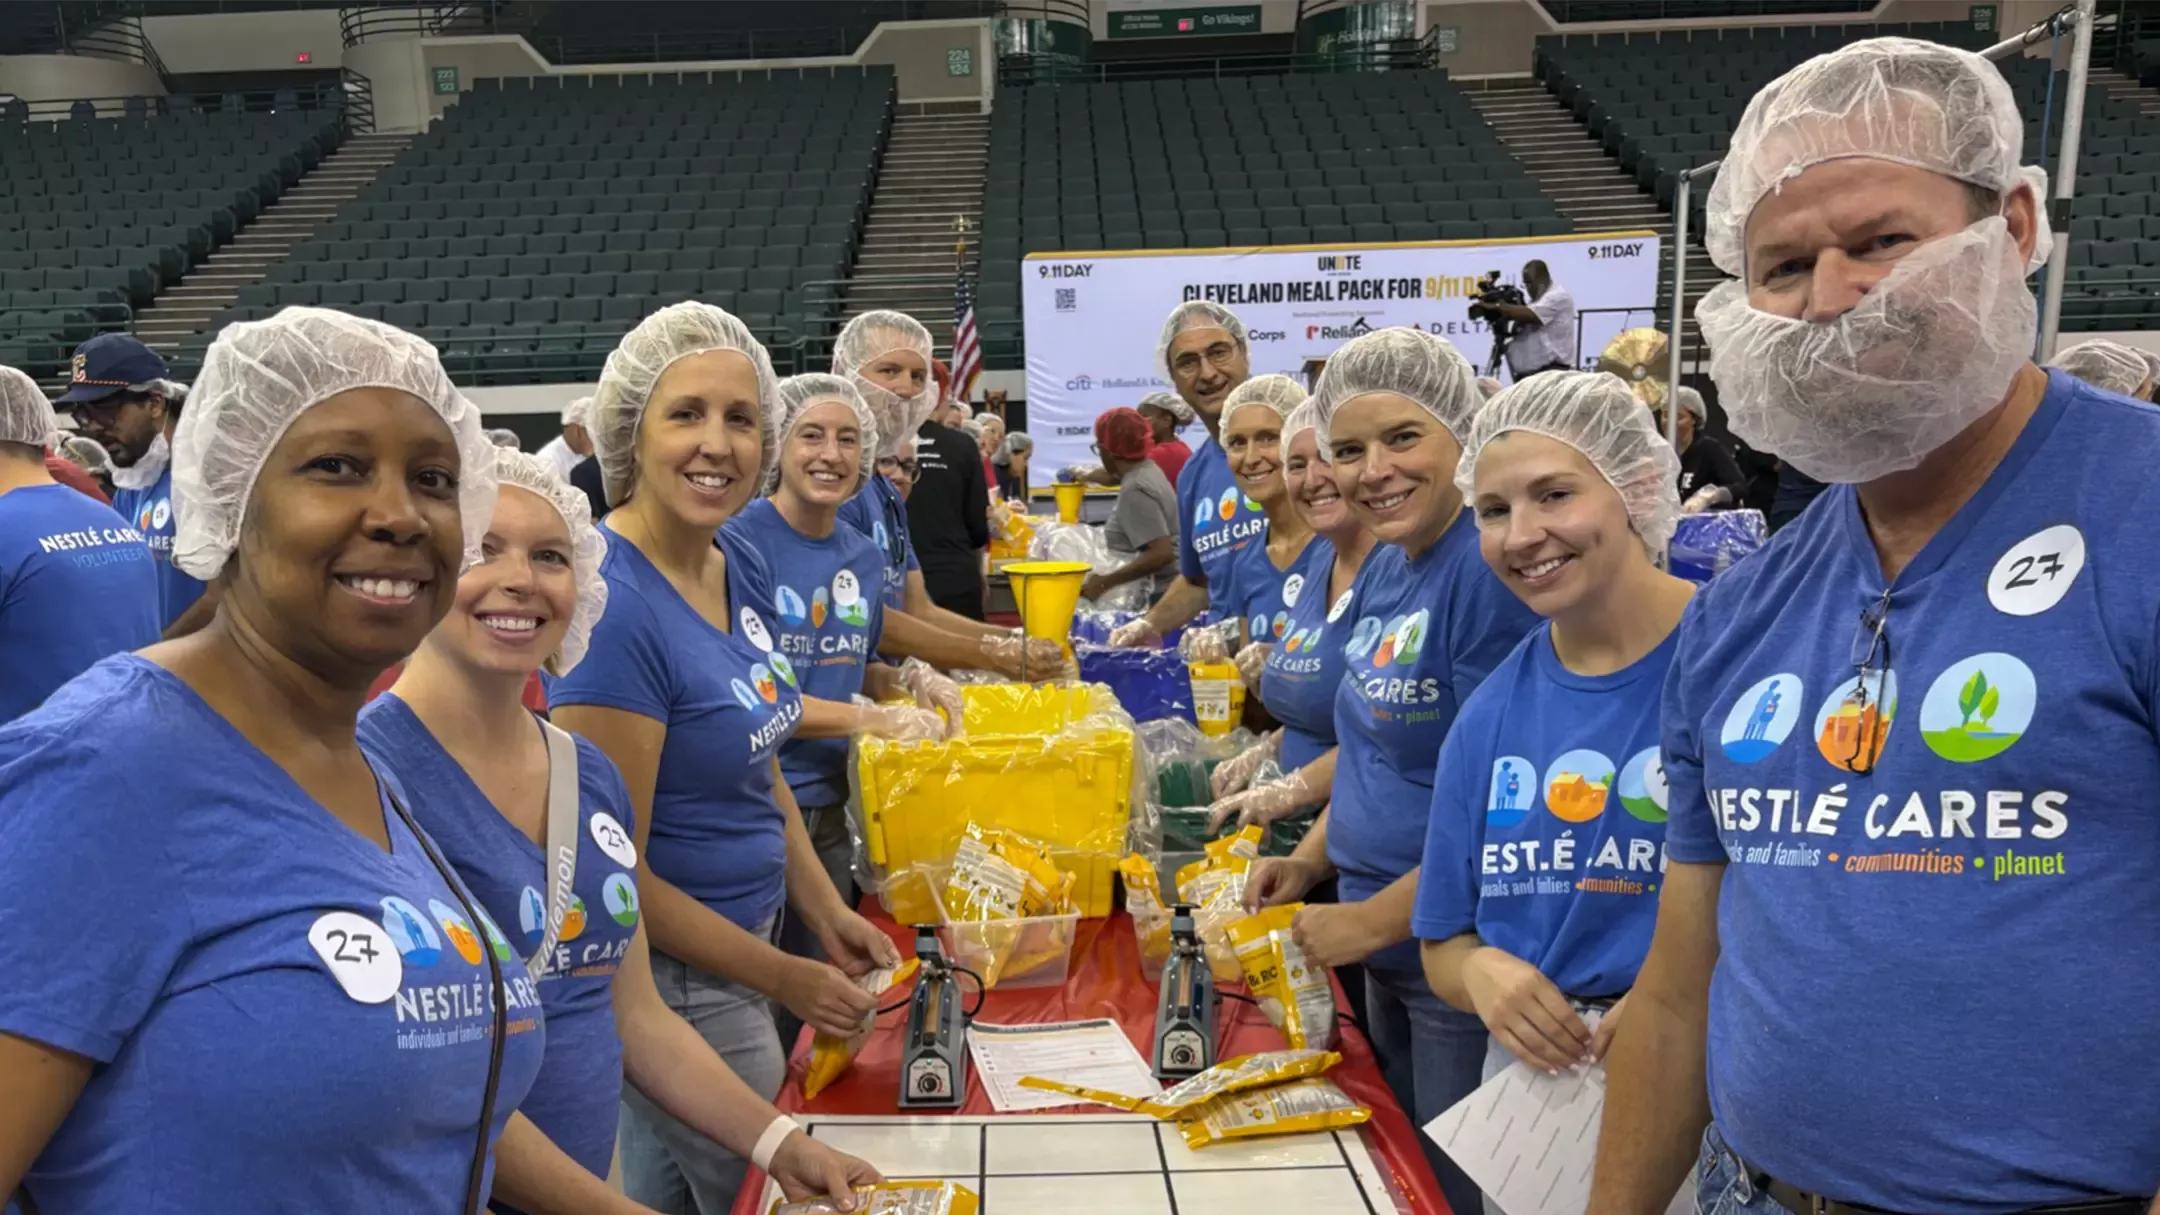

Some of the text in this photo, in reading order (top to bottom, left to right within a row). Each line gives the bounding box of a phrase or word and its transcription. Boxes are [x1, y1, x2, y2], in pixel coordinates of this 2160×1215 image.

[1202, 15, 1215, 25] Go
[1217, 14, 1255, 26] Vikings!
[949, 50, 970, 61] 224
[950, 66, 969, 75] 124
[1183, 282, 1284, 304] CLEVELAND
[1287, 280, 1334, 303] MEAL
[1338, 278, 1385, 302] PACK
[1388, 277, 1422, 300] FOR
[1425, 275, 1459, 300] 9/11
[1321, 325, 1375, 339] Relian
[1066, 376, 1092, 391] citi
[38, 525, 103, 553] NESTLÉ
[1194, 523, 1230, 553] ESTLÉ
[1232, 518, 1270, 539] CAR
[2005, 552, 2065, 590] 27
[820, 633, 869, 655] CARE
[1283, 658, 1321, 672] CARES
[749, 706, 789, 752] NESTLÉ
[1864, 790, 2069, 839] CARES
[1482, 829, 1576, 875] ESTÉ
[1746, 841, 1773, 864] and
[1845, 849, 1964, 873] communities
[1994, 849, 2065, 880] planet
[1512, 877, 1535, 895] and
[326, 929, 380, 964] 27
[583, 938, 629, 963] CAR
[395, 973, 541, 1022] NESTLÉ CARE
[397, 1028, 446, 1049] individuals
